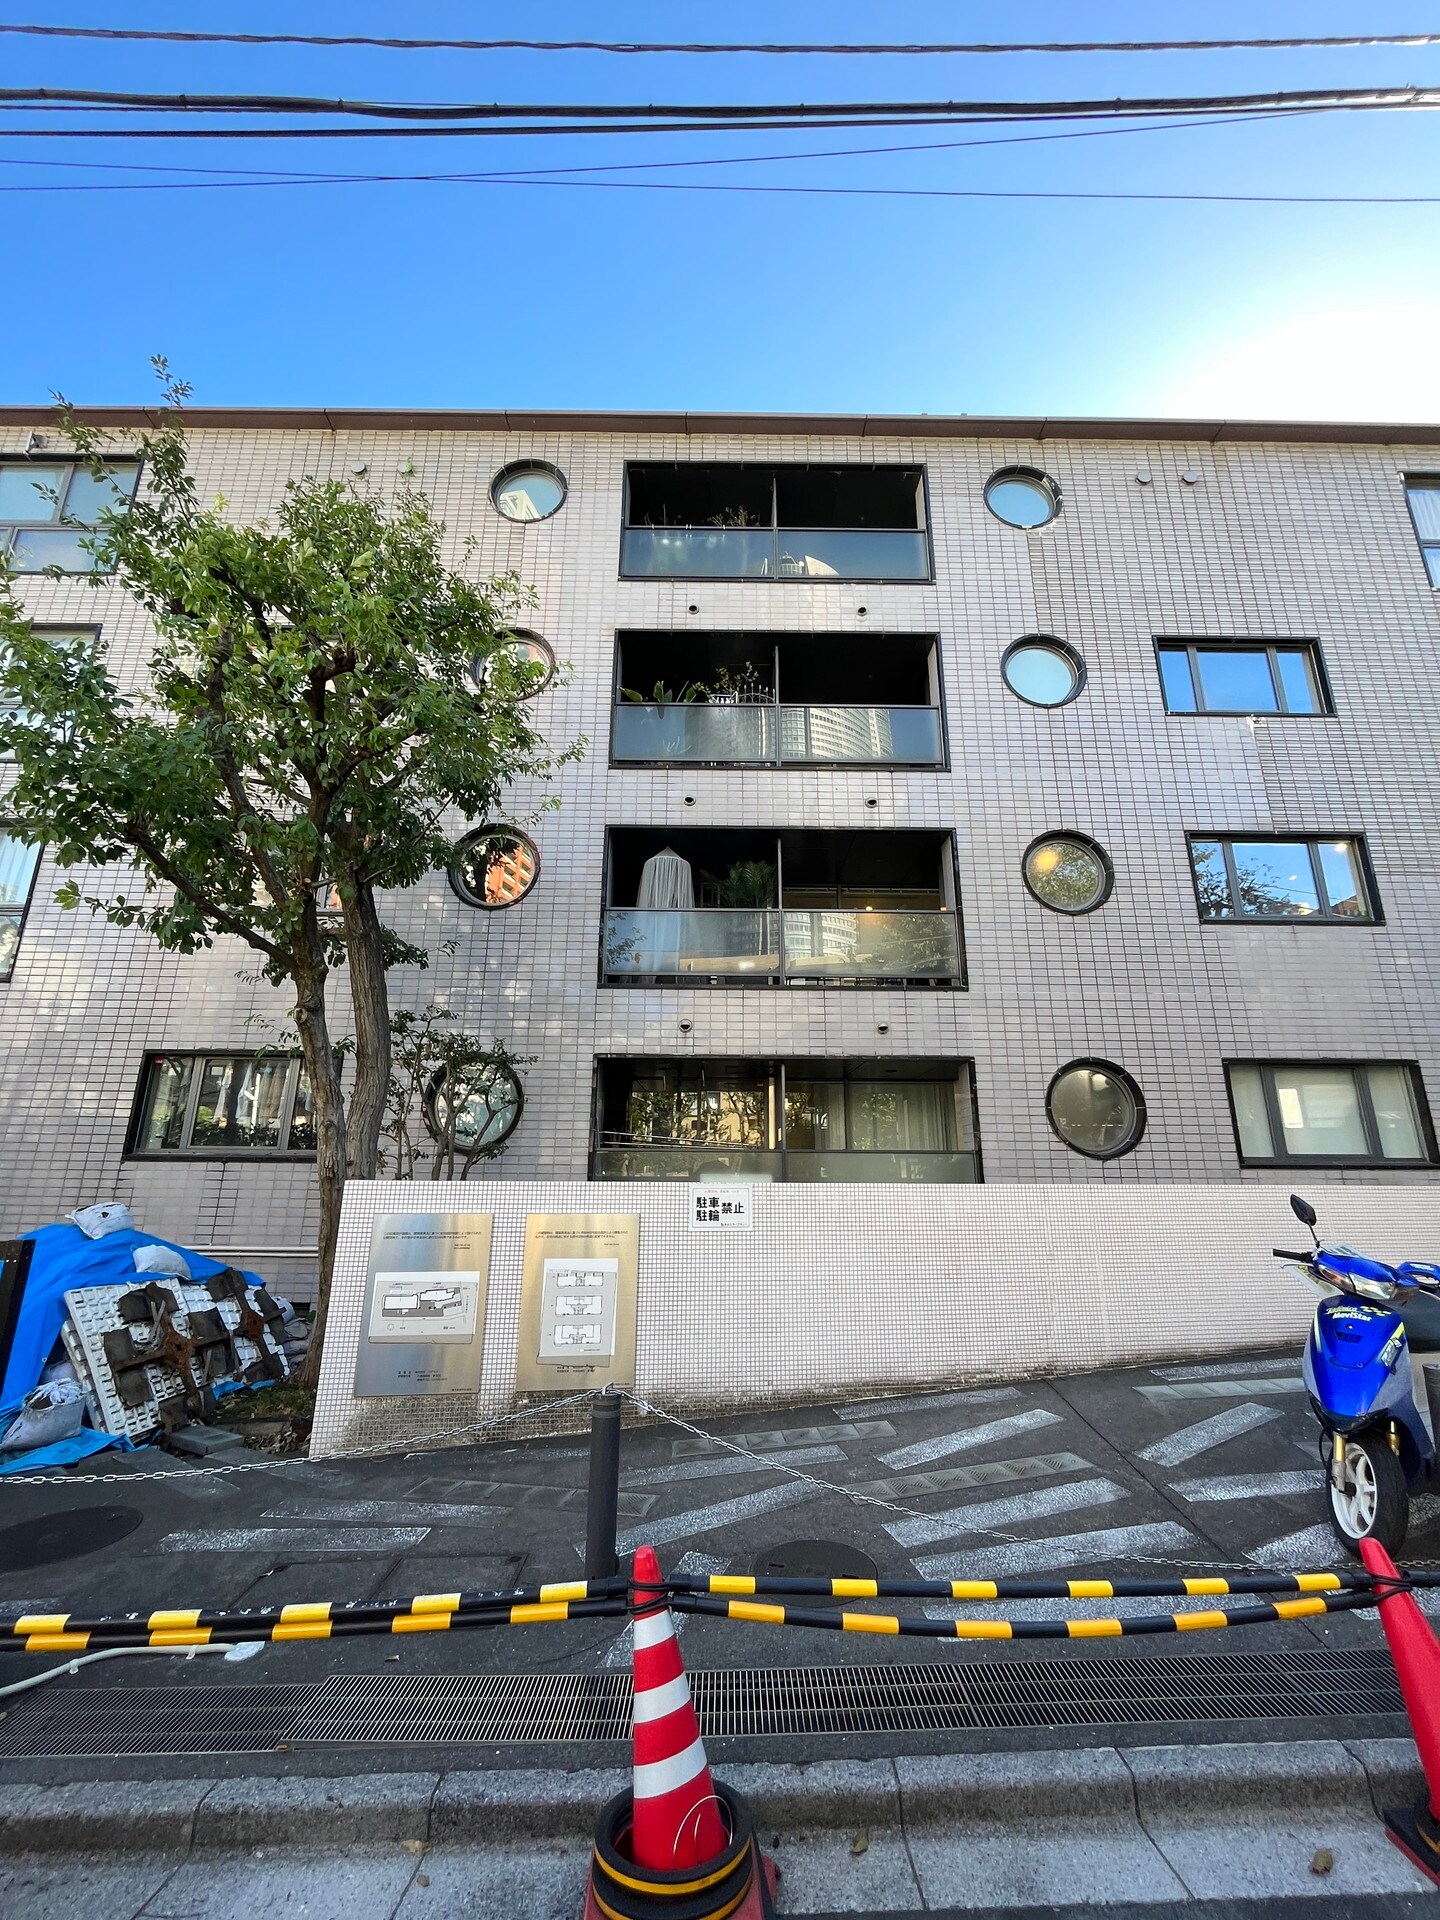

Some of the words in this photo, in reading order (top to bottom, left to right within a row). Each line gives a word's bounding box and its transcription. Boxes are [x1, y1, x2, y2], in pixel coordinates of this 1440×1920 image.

[696, 1197, 720, 1209] 駐車
[721, 1202, 745, 1214] 禁止
[696, 1210, 720, 1222] 駐輪
